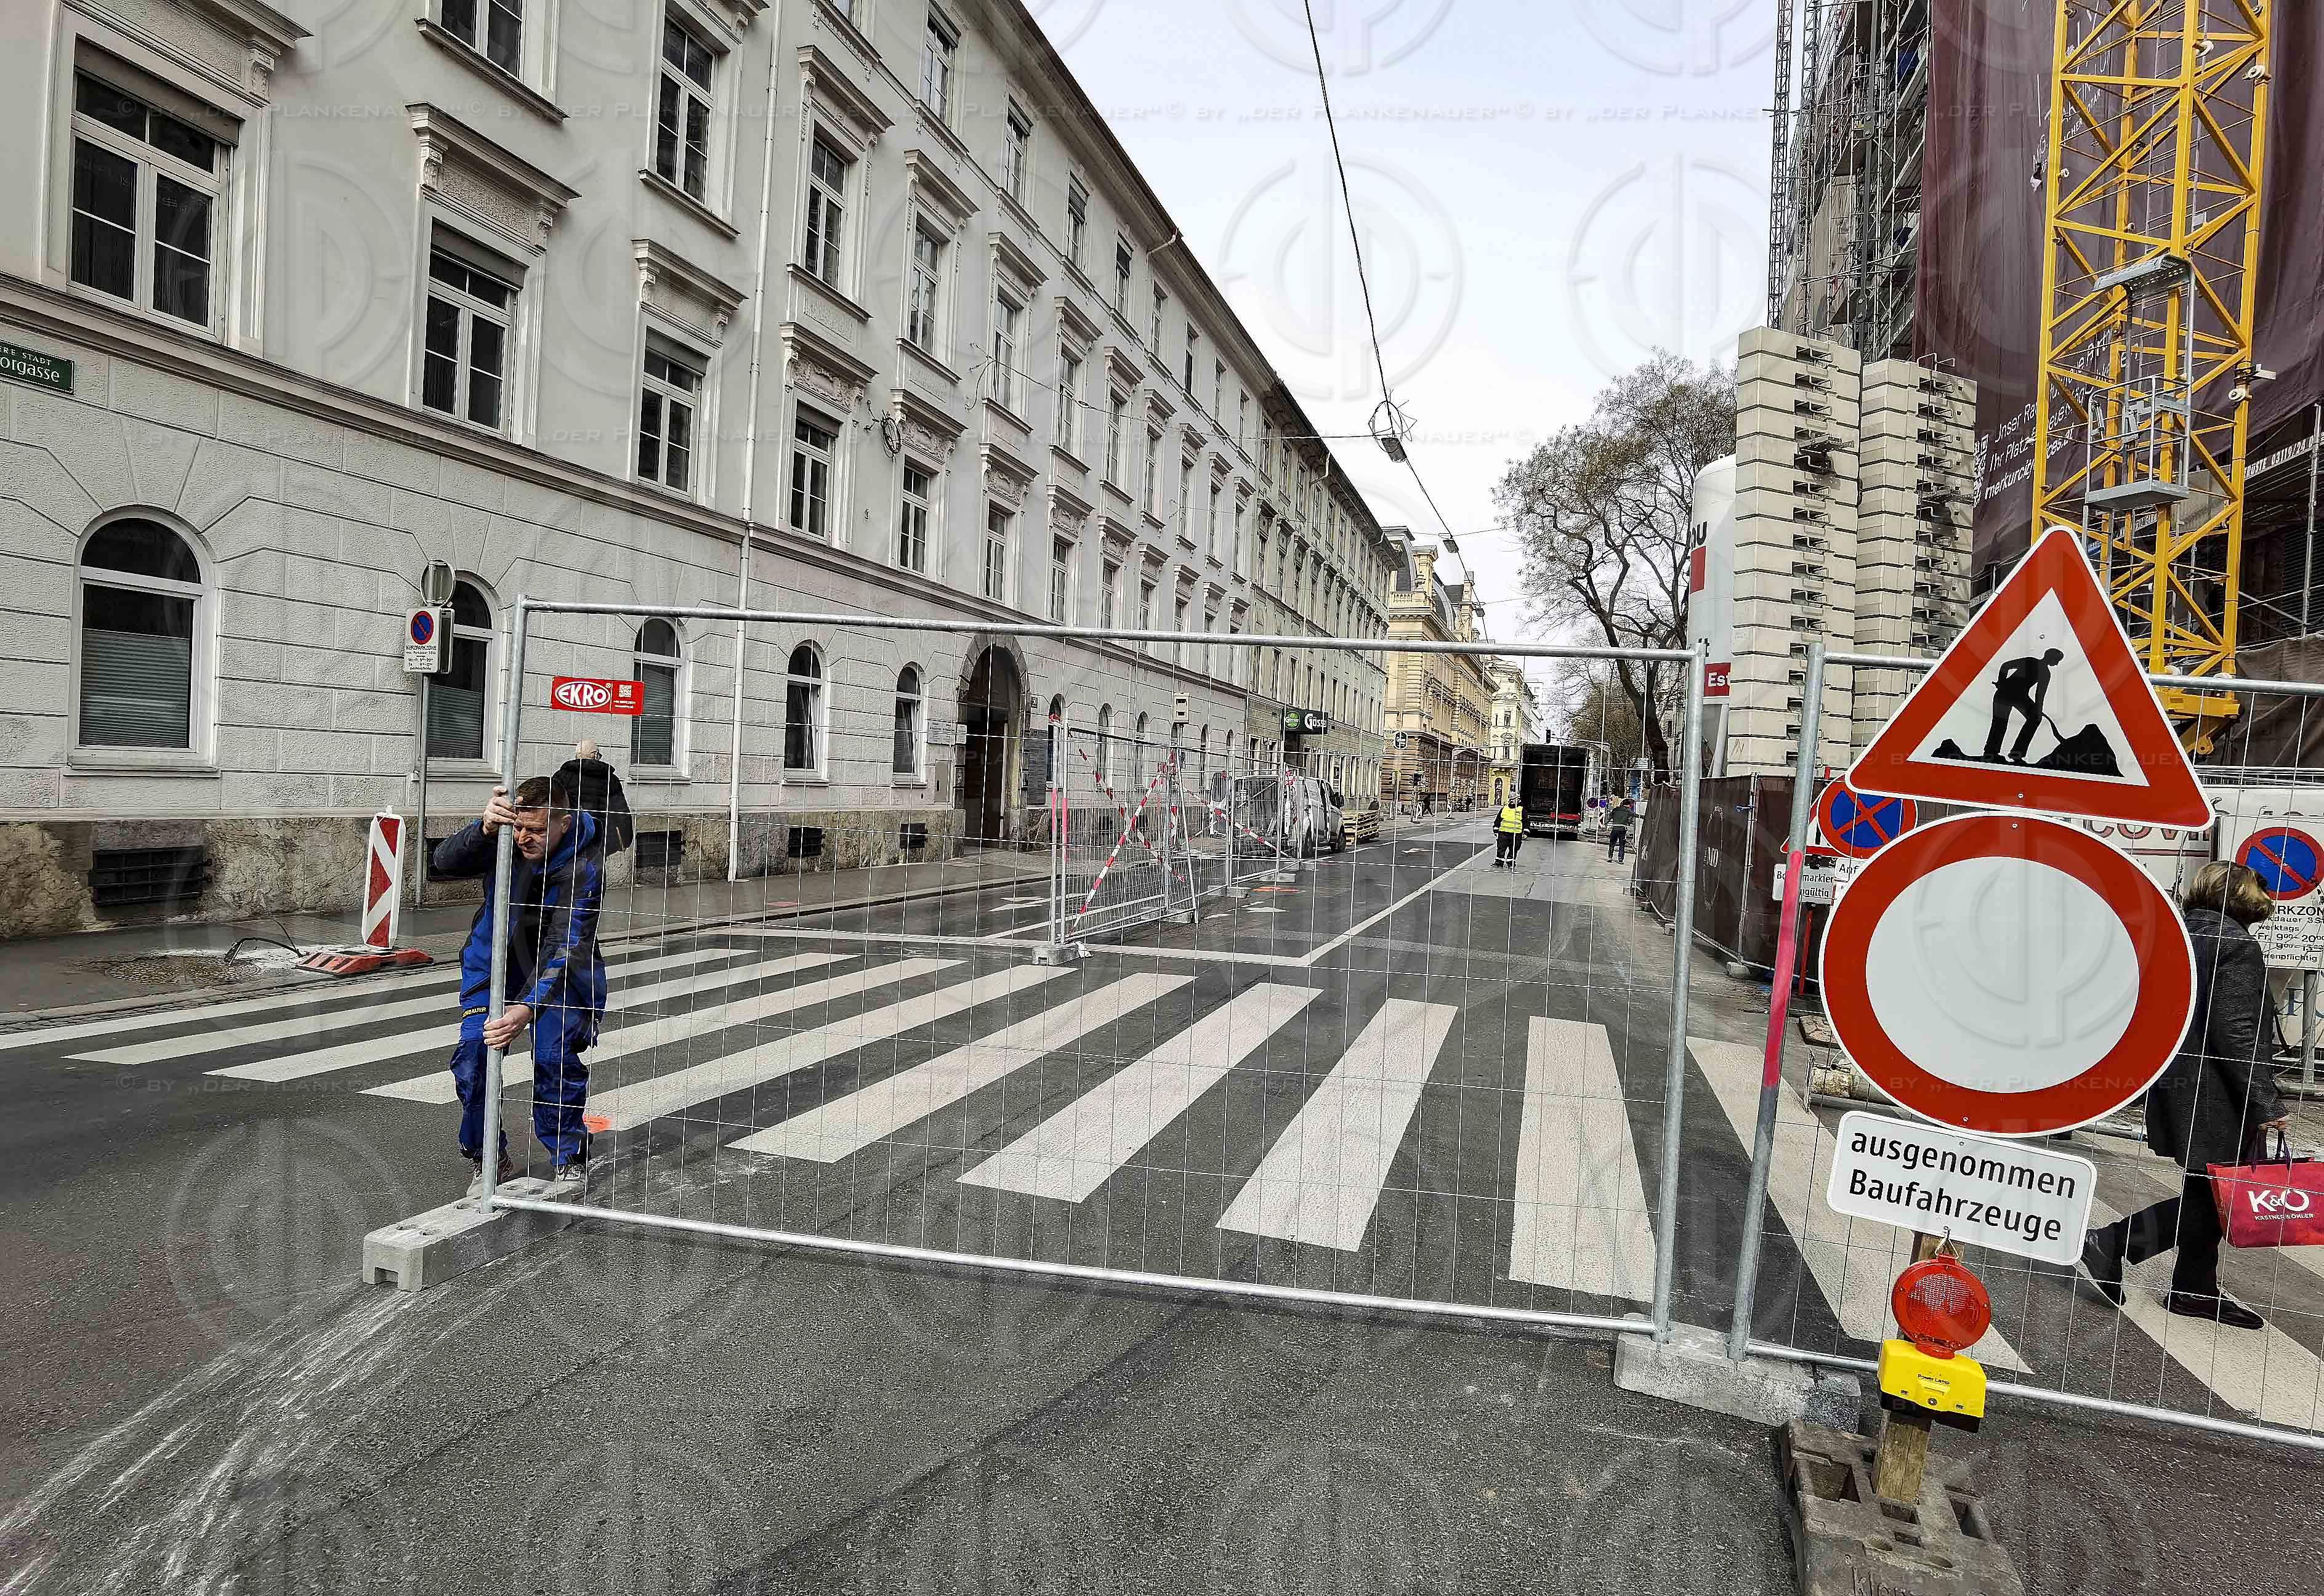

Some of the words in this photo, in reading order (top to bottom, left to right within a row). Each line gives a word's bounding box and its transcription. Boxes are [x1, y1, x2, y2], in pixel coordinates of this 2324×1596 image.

[22, 353, 52, 366] STADT
[1989, 453, 2004, 472] Ihr
[557, 683, 607, 706] EKRO
[1851, 1132, 2076, 1198] ausgenommen
[1849, 1169, 2062, 1242] Baufahrzeuge
